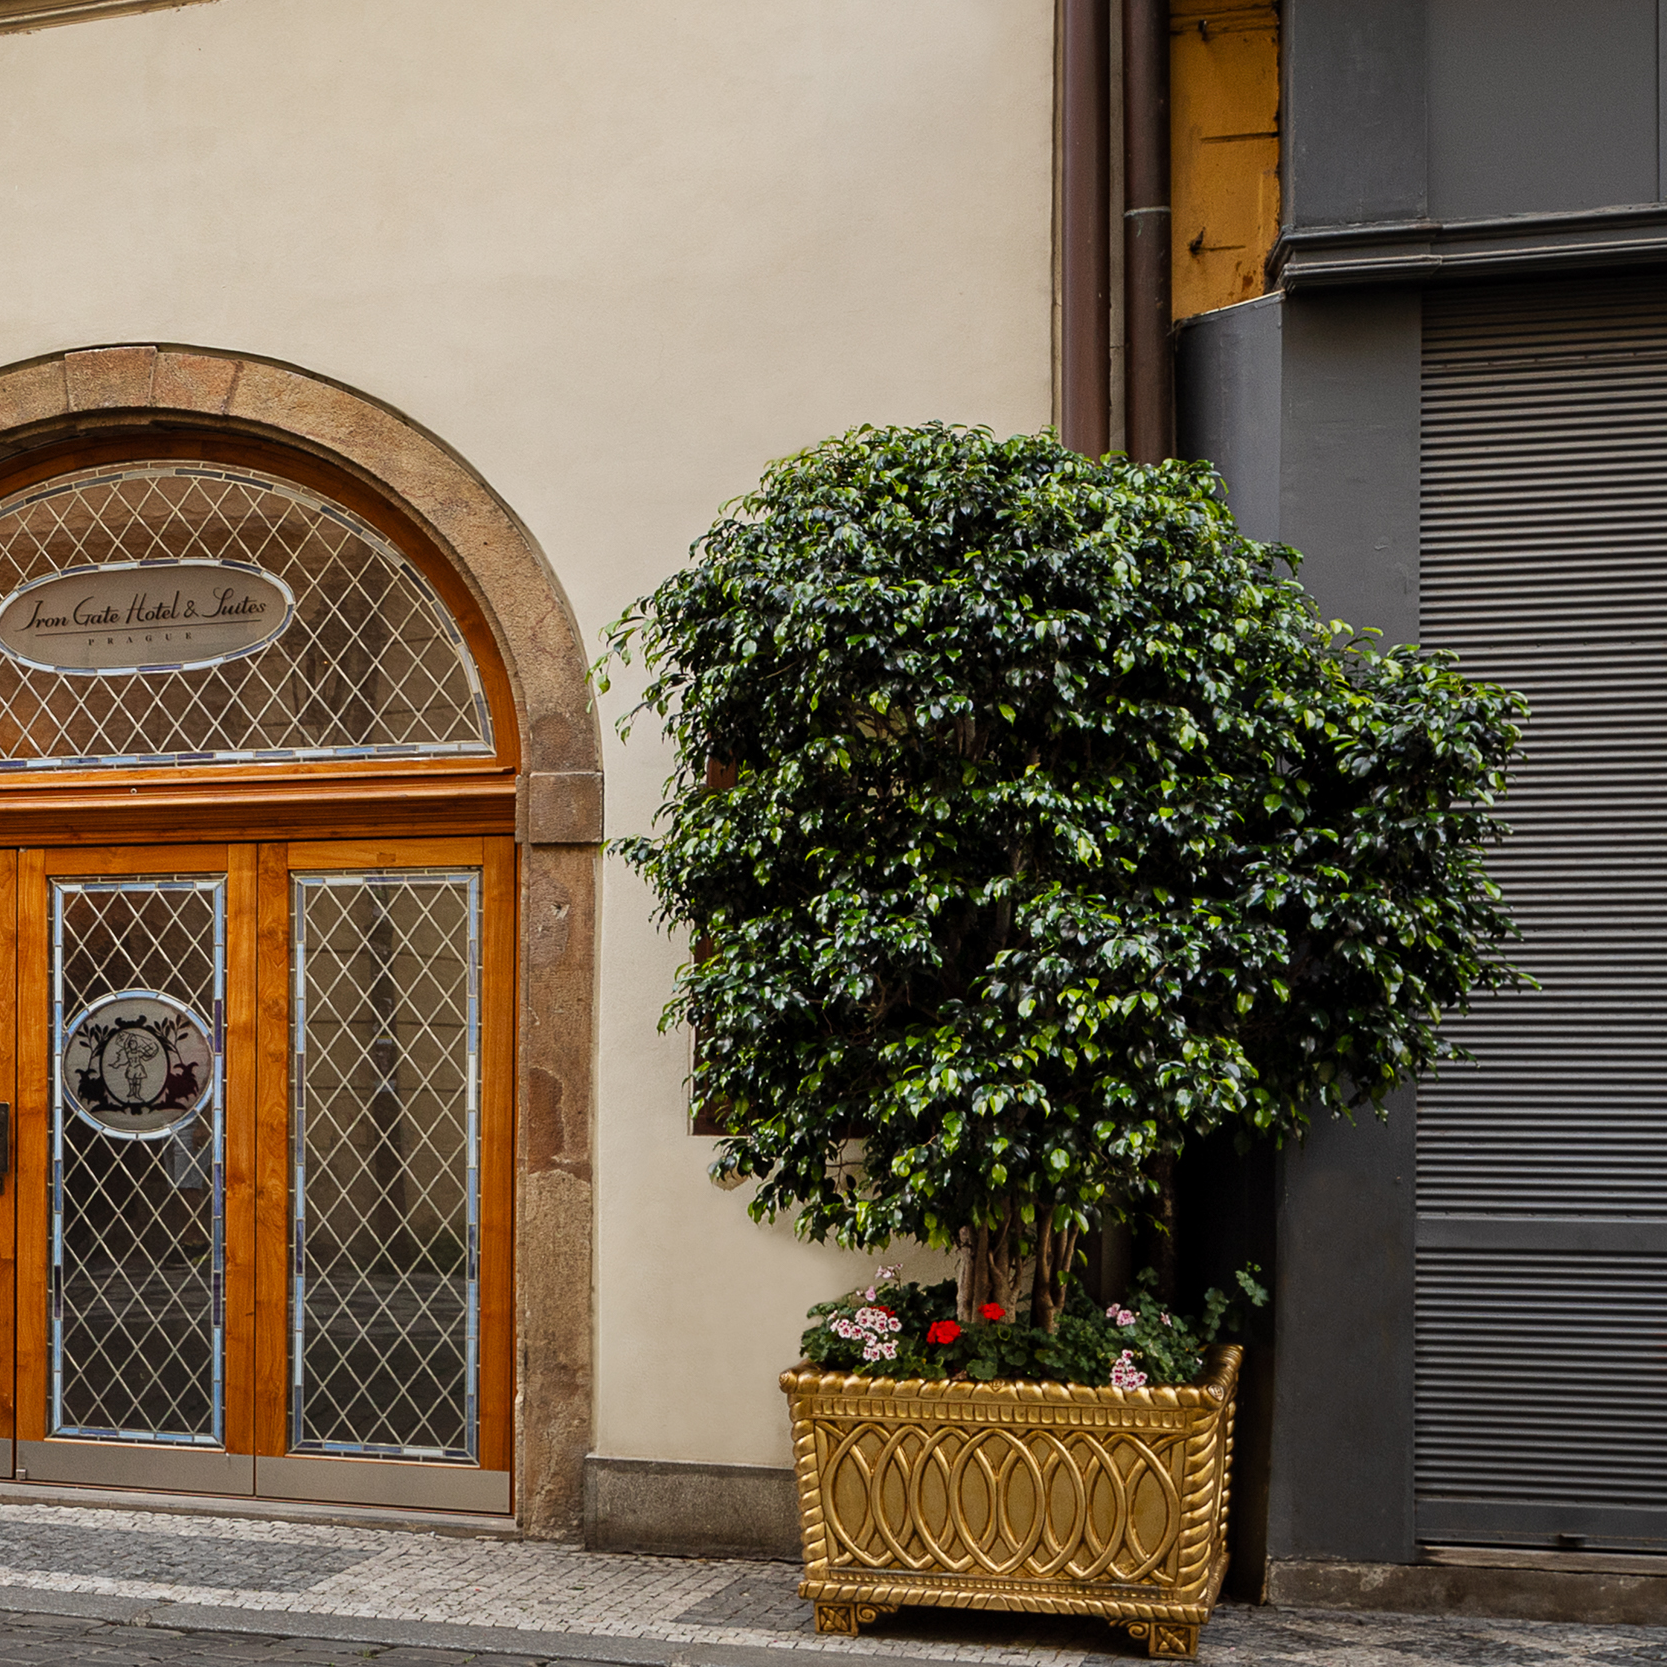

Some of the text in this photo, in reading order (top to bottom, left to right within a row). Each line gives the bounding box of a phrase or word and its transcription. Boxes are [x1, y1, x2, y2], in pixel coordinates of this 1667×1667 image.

[14, 587, 267, 632] Iron Gate Hotel & Suites
[88, 631, 193, 647] PRAGUE
